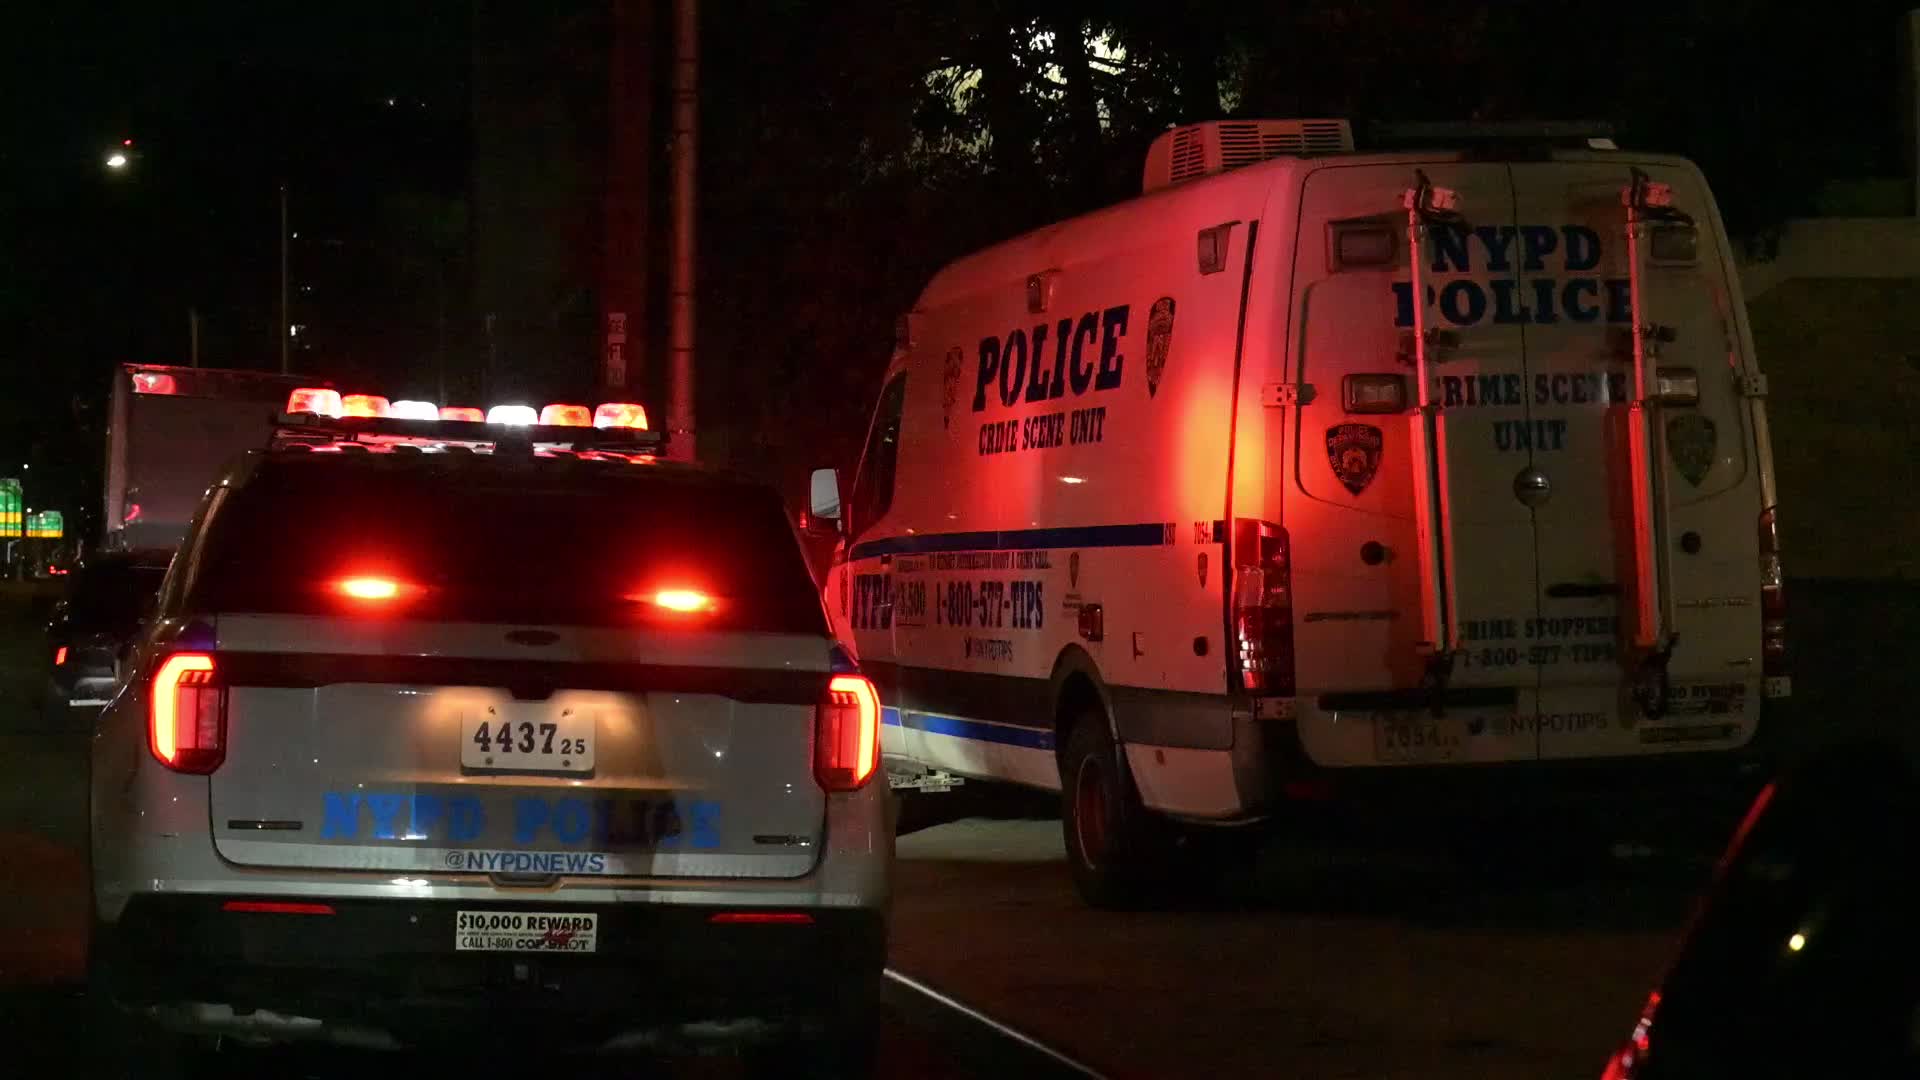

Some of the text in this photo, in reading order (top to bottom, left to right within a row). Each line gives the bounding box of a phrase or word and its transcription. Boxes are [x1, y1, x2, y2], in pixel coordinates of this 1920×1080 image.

[1428, 223, 1602, 272] NYPD
[972, 304, 1130, 412] POLICE
[978, 406, 1106, 456] CRIME SCENE UNIT
[1493, 420, 1568, 450] UNIT
[936, 580, 1043, 629] 1-800-577-TIPS
[474, 722, 586, 755] 4437 25
[320, 791, 488, 841] NYPD
[444, 851, 606, 873] @NYPDNEWS
[459, 914, 593, 931] $10,000 REWARD
[462, 937, 484, 949] CALL
[487, 937, 513, 950] 1-800
